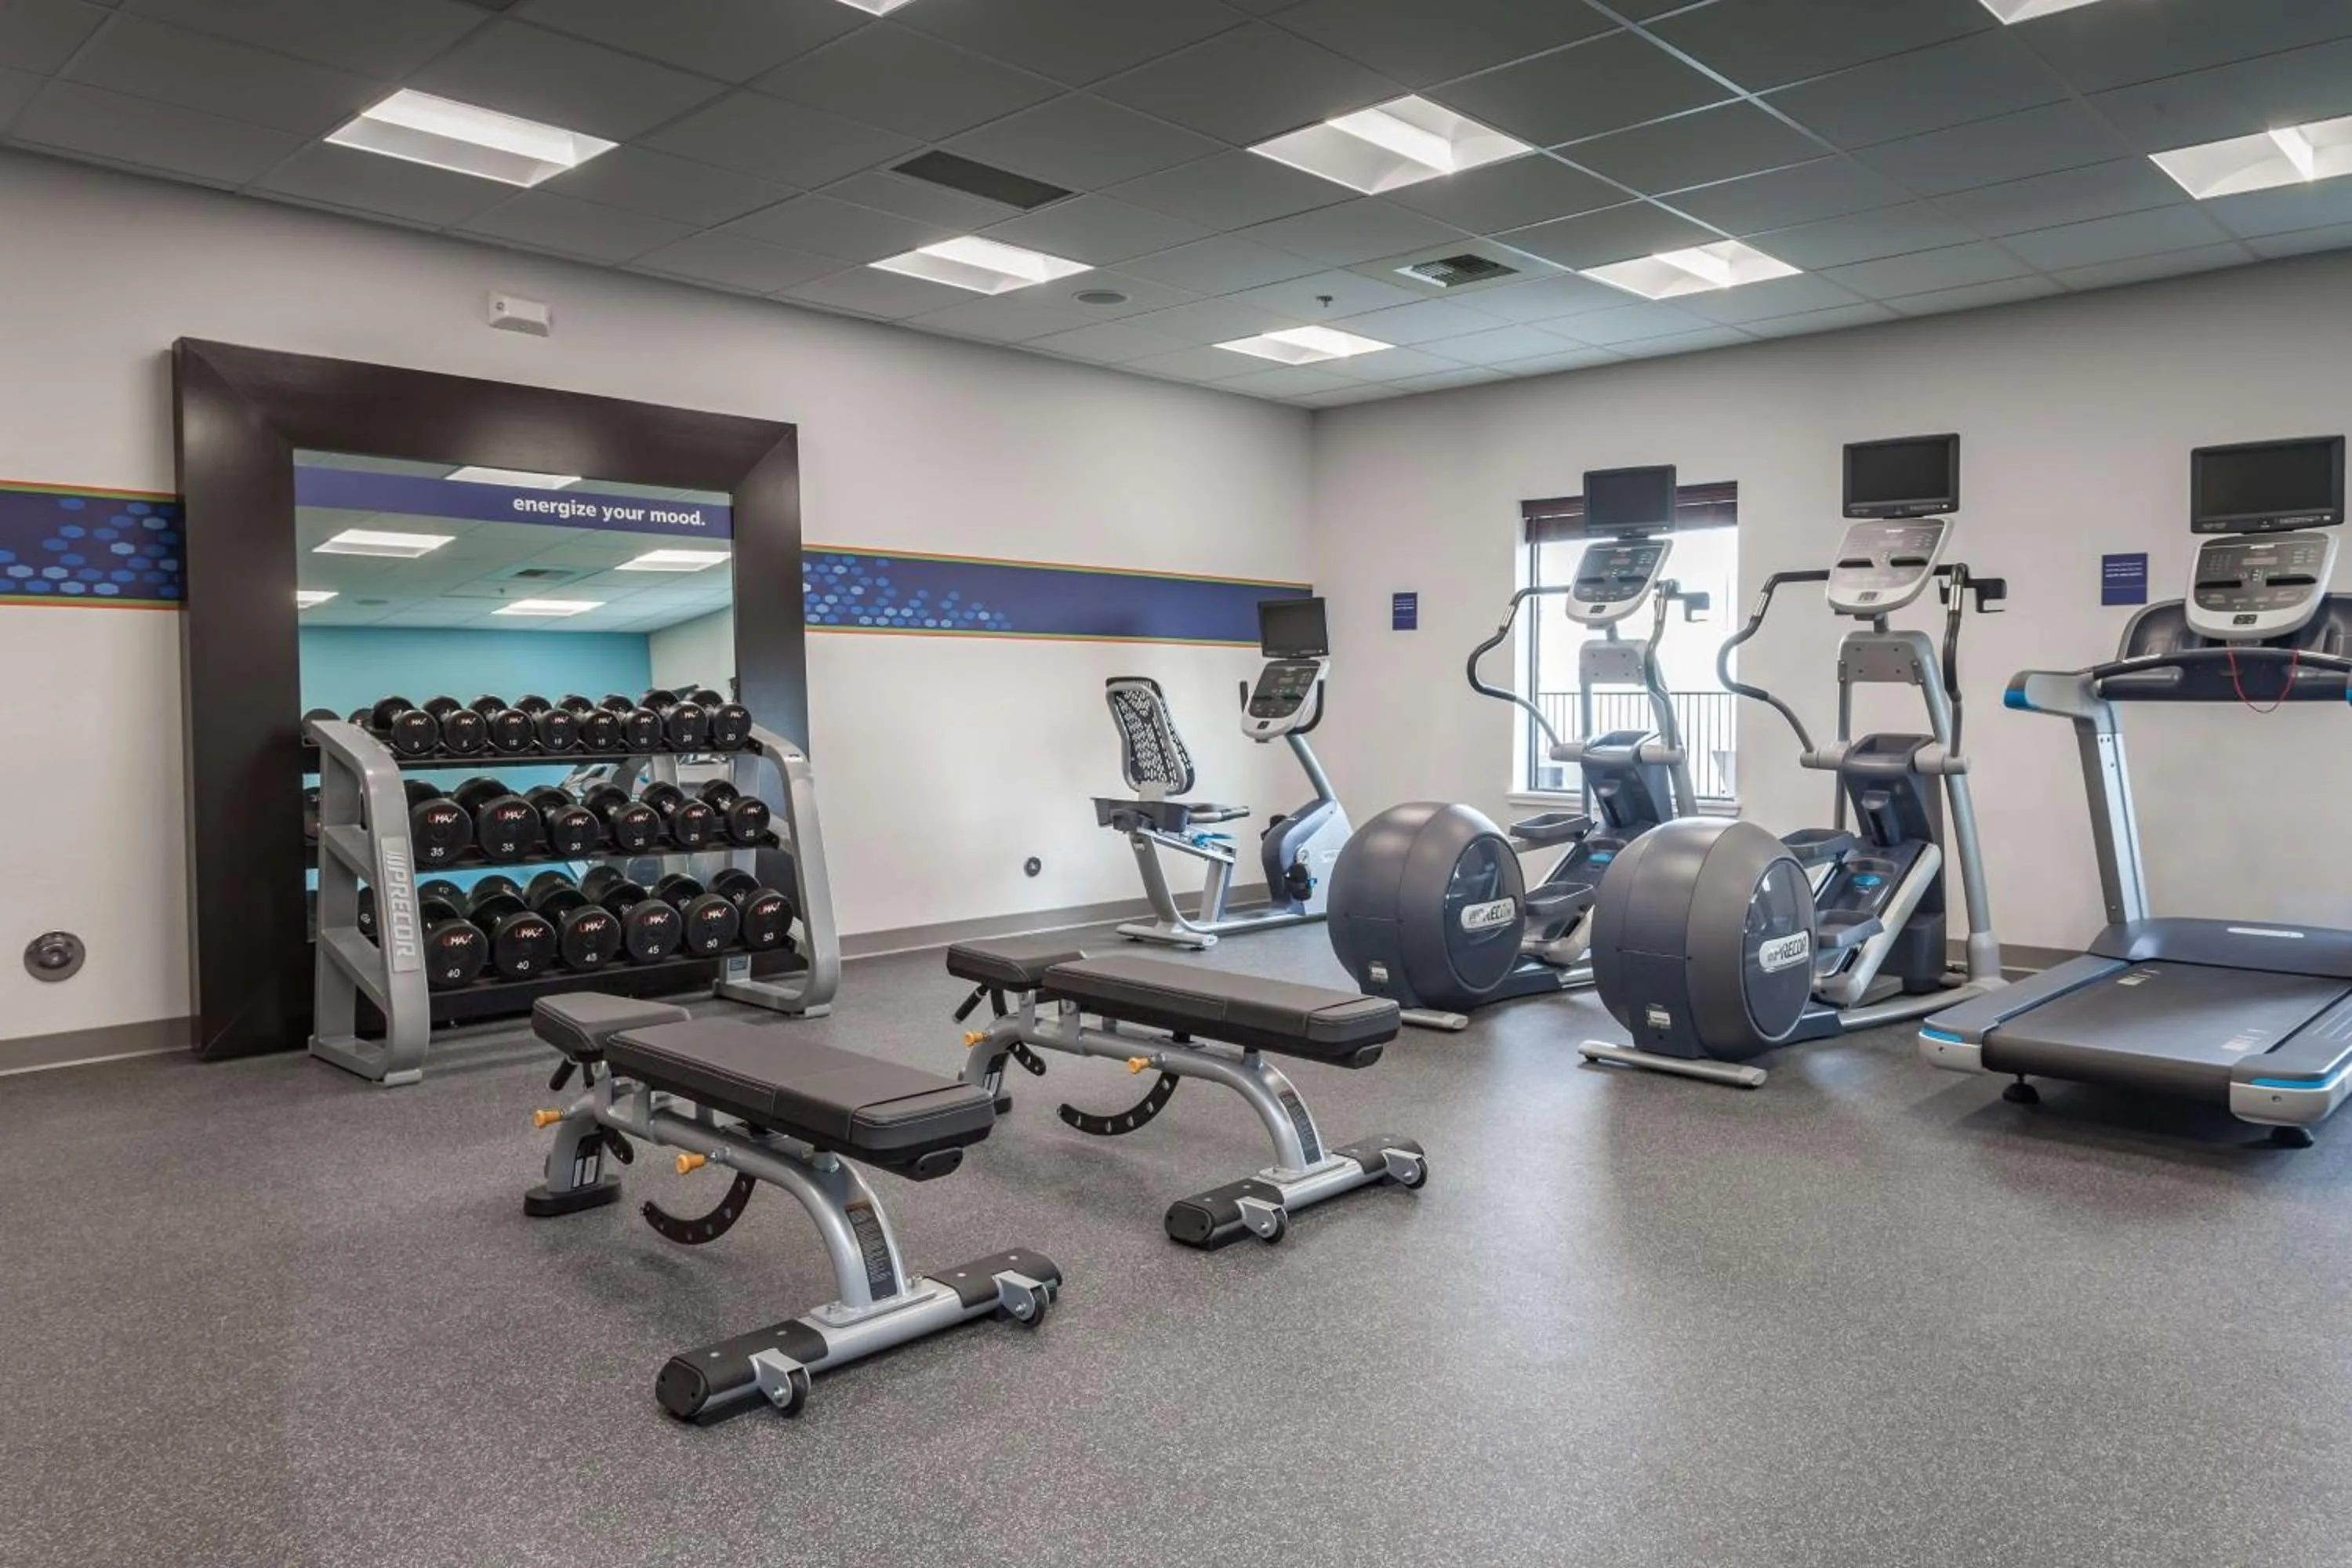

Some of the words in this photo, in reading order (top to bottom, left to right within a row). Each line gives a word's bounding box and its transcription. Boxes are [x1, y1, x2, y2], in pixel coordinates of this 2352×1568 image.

[513, 498, 597, 519] energize
[601, 506, 645, 522] your
[650, 510, 706, 526] mood.
[430, 847, 445, 857] 35
[501, 843, 515, 852] 35
[388, 865, 416, 956] PRECOR
[763, 931, 775, 942] 50
[706, 938, 718, 948] 50
[648, 945, 659, 954] 45
[516, 960, 530, 971] 40
[447, 968, 461, 978] 40
